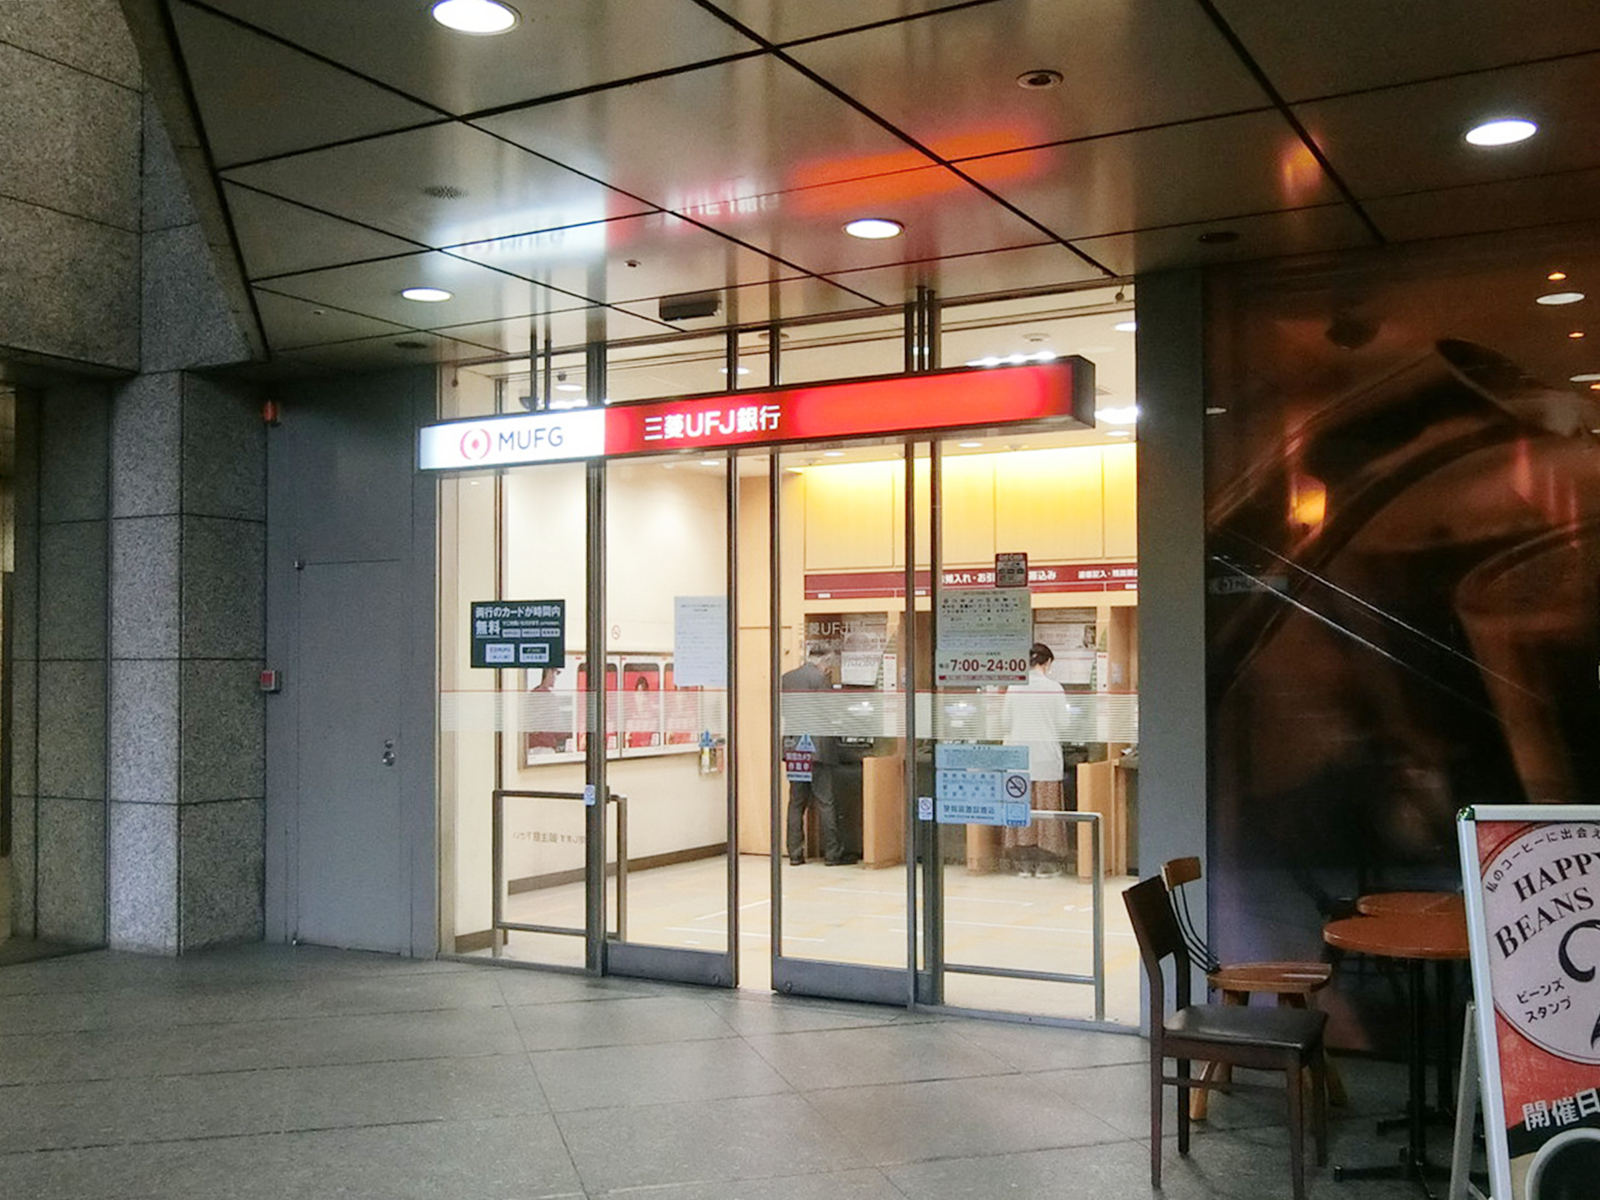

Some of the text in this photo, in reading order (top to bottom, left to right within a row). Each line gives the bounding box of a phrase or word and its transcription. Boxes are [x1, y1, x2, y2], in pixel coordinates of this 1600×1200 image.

[643, 405, 782, 441] 三菱UFJ銀行
[498, 427, 564, 451] MUFG
[476, 619, 501, 635] 無料
[1493, 886, 1594, 960] BEANS
[1516, 976, 1565, 1005] ビーンズ
[1525, 994, 1572, 1024] スタンプ
[1521, 1087, 1600, 1132] 開催日
